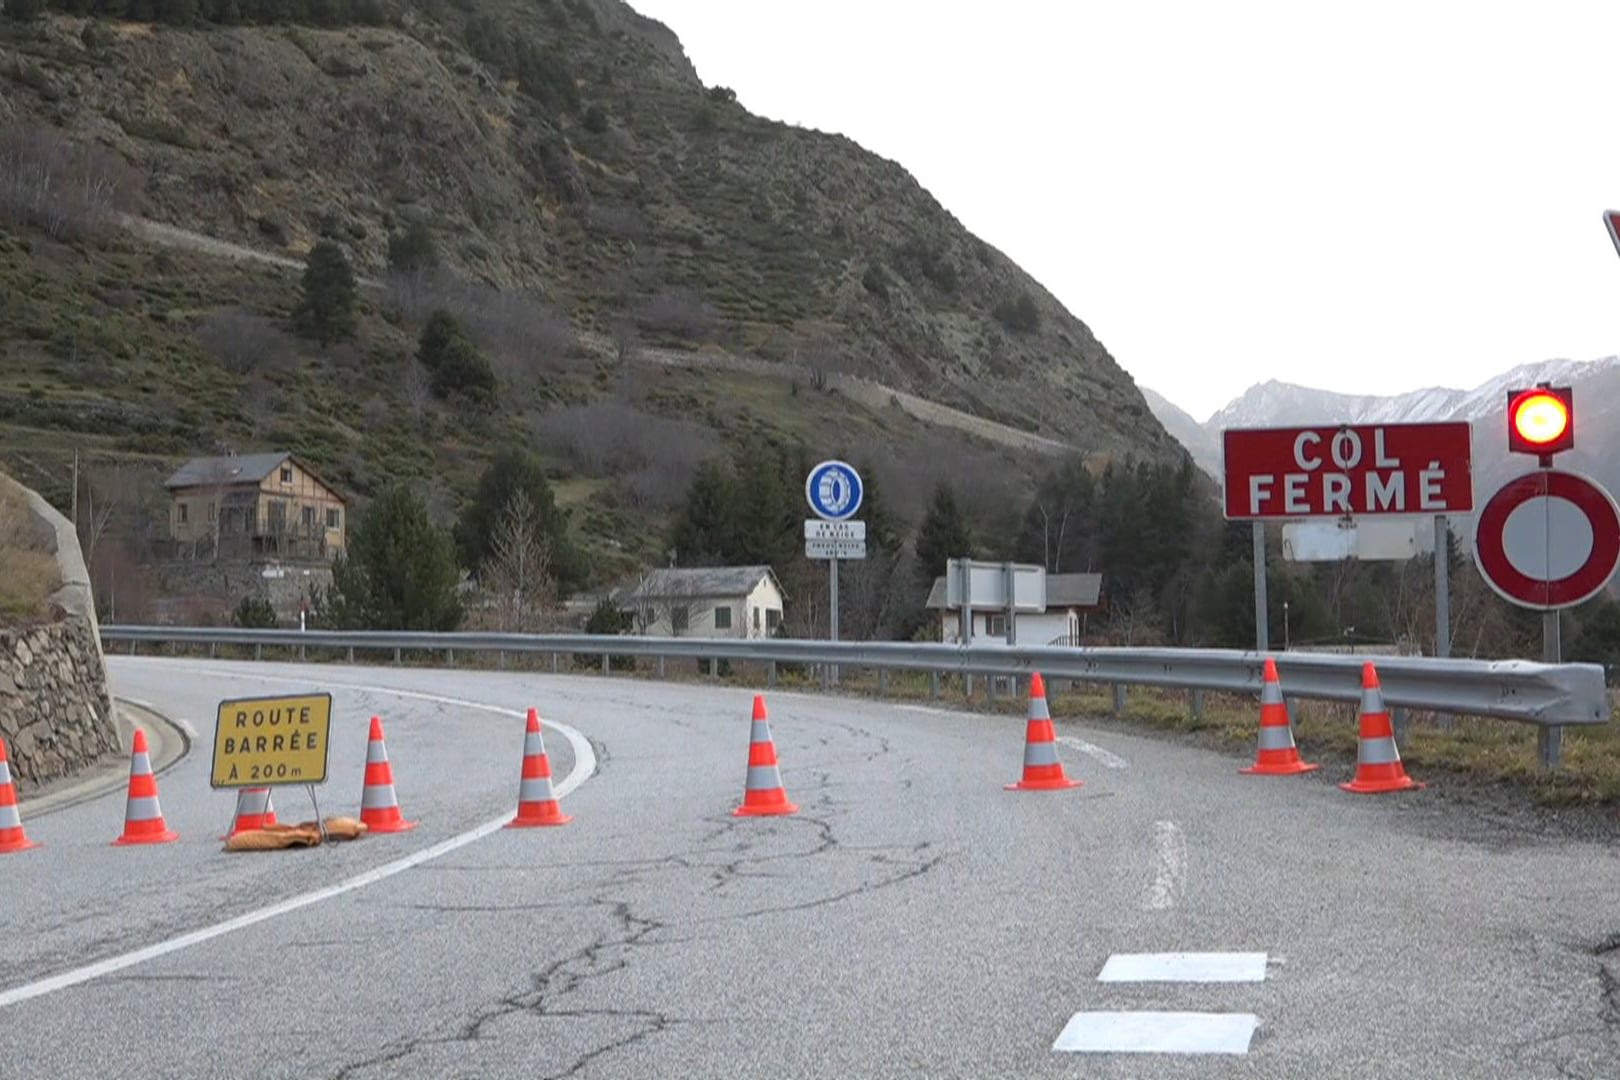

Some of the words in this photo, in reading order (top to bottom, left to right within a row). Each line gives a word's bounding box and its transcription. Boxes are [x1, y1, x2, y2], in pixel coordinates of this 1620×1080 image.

[1293, 428, 1400, 471] COL
[1249, 460, 1447, 514] FERMÉ
[235, 706, 311, 728] ROUTE
[224, 728, 318, 755] BARRÉE
